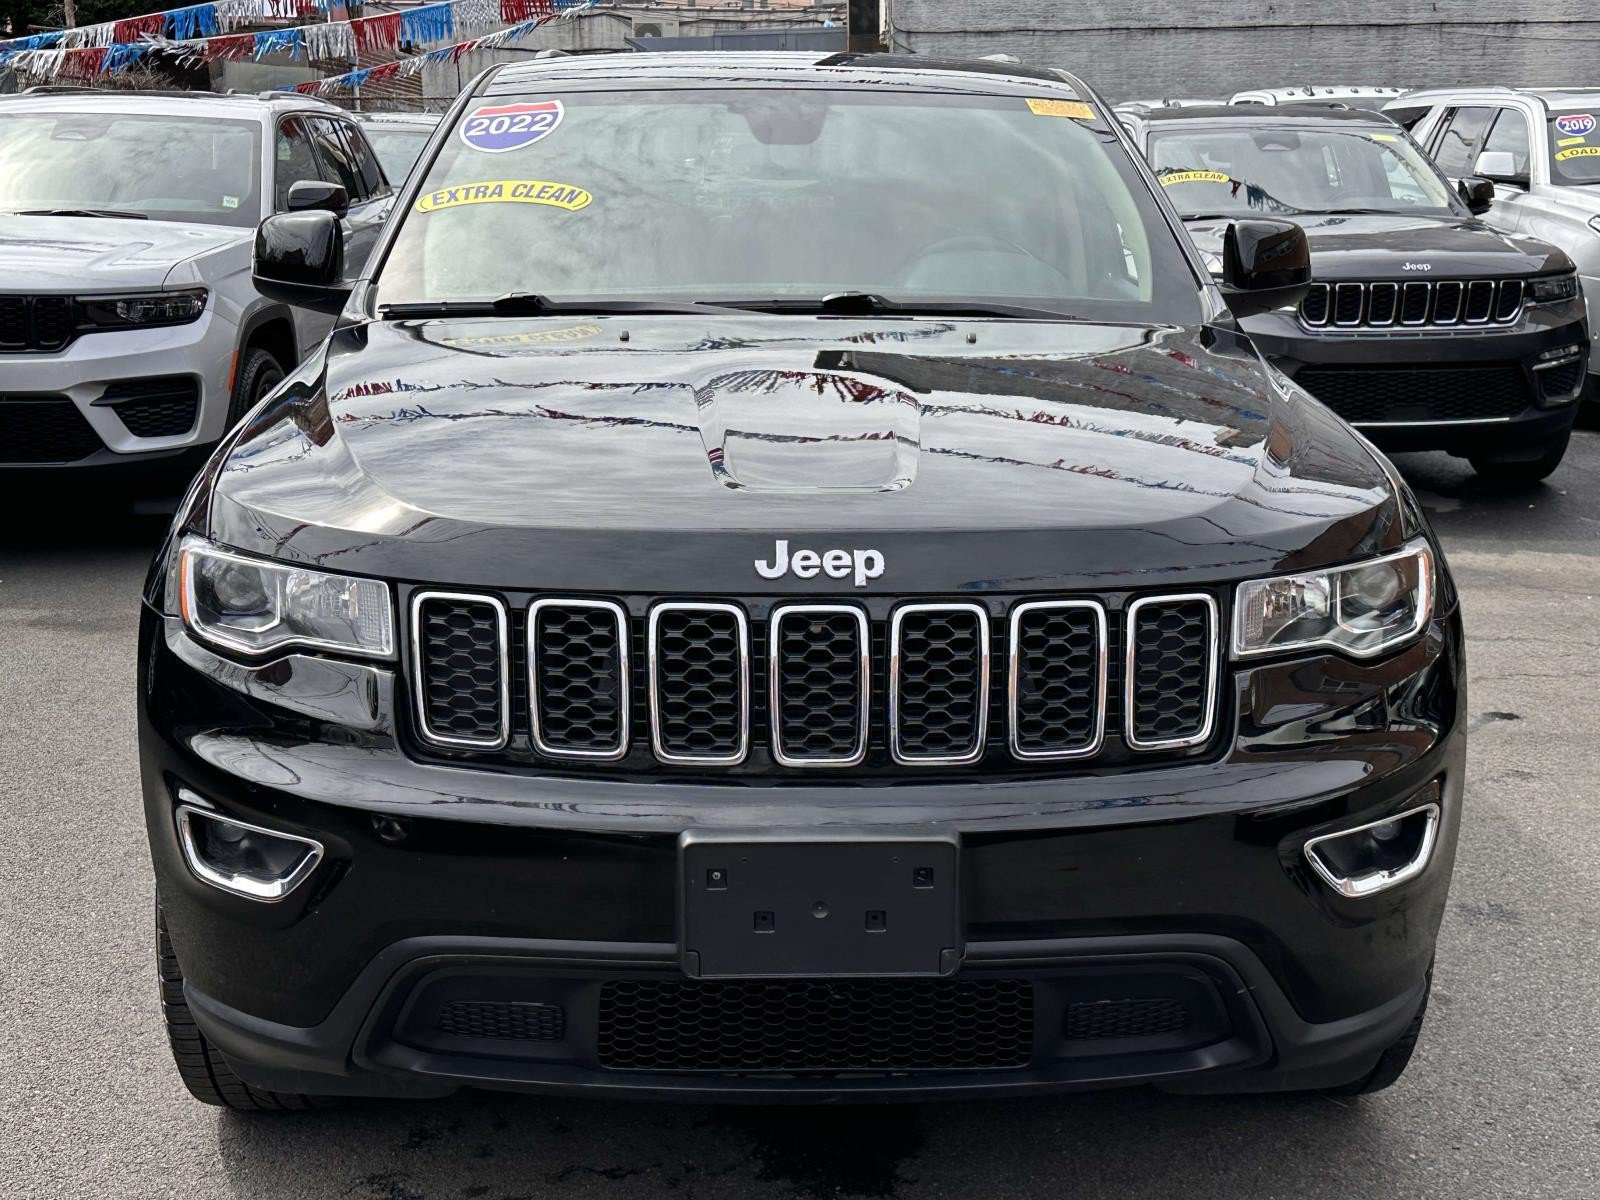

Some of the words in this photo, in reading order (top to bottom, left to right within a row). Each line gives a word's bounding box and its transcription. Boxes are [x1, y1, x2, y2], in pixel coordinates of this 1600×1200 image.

[466, 113, 554, 137] 2022
[1562, 119, 1593, 131] 2019
[1160, 173, 1191, 184] EXTRA
[1193, 172, 1223, 181] CLEAN
[432, 184, 503, 206] EXTRA
[511, 183, 582, 205] CLEAN
[1402, 262, 1431, 271] Jeep
[754, 540, 885, 587] Jeep
